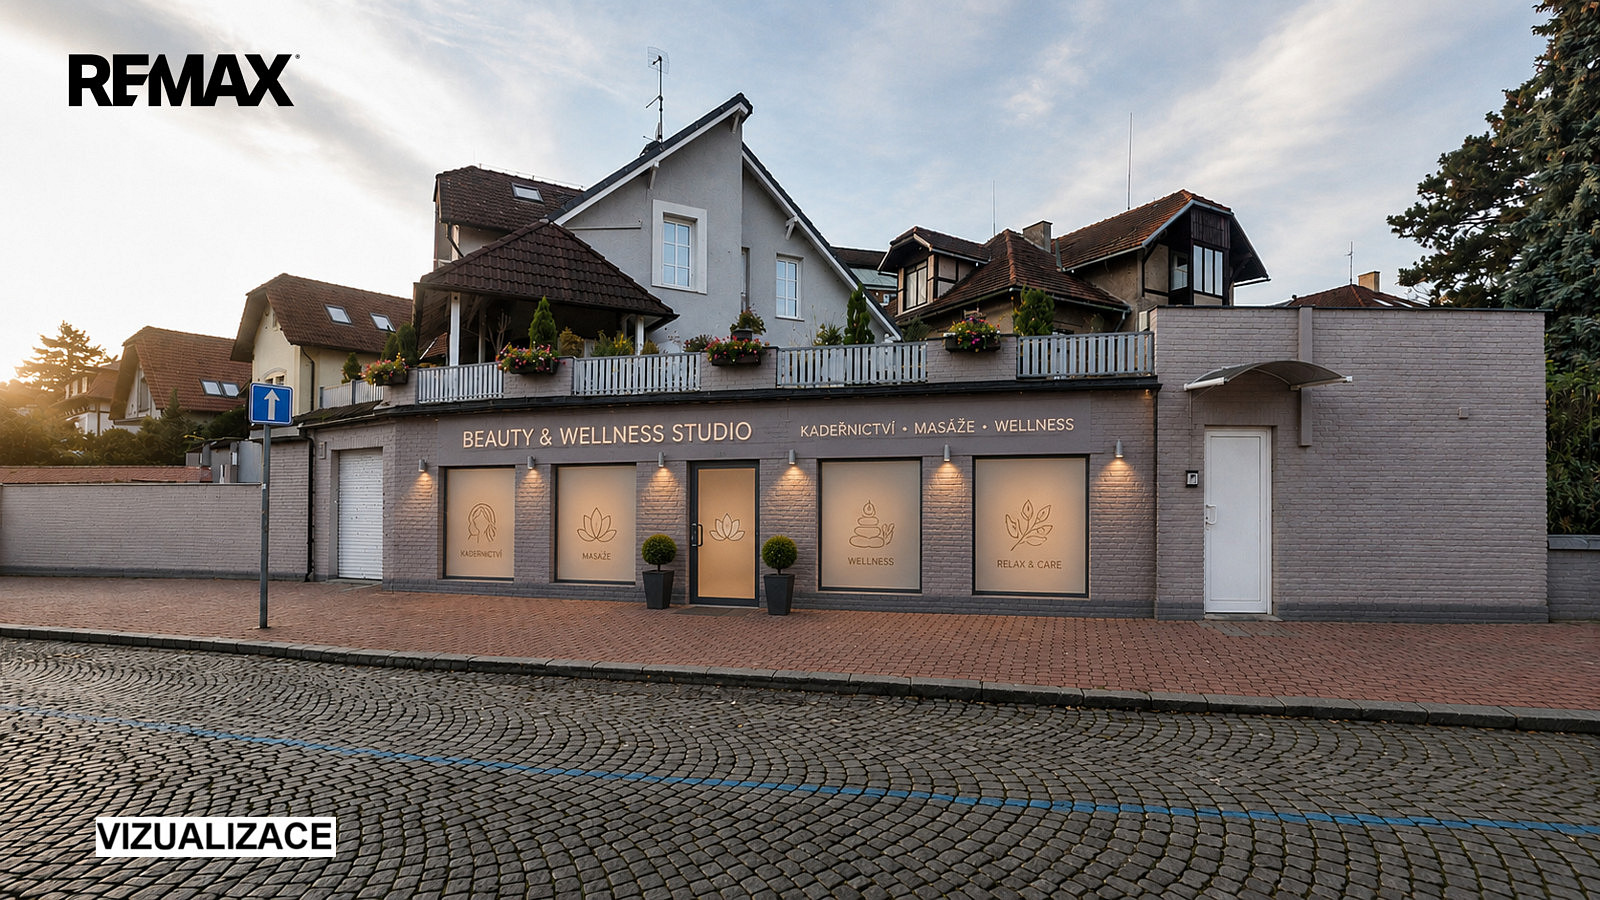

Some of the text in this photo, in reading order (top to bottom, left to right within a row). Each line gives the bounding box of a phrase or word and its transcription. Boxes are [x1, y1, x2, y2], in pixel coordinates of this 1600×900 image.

[462, 421, 752, 449] BEAUTY & WELLNESS STUDIO
[799, 416, 1075, 438] KADEŘNICTVÍ MASÁŽE WELLNESS
[847, 556, 895, 567] WELLNESS
[996, 559, 1063, 570] RELAX & CARE
